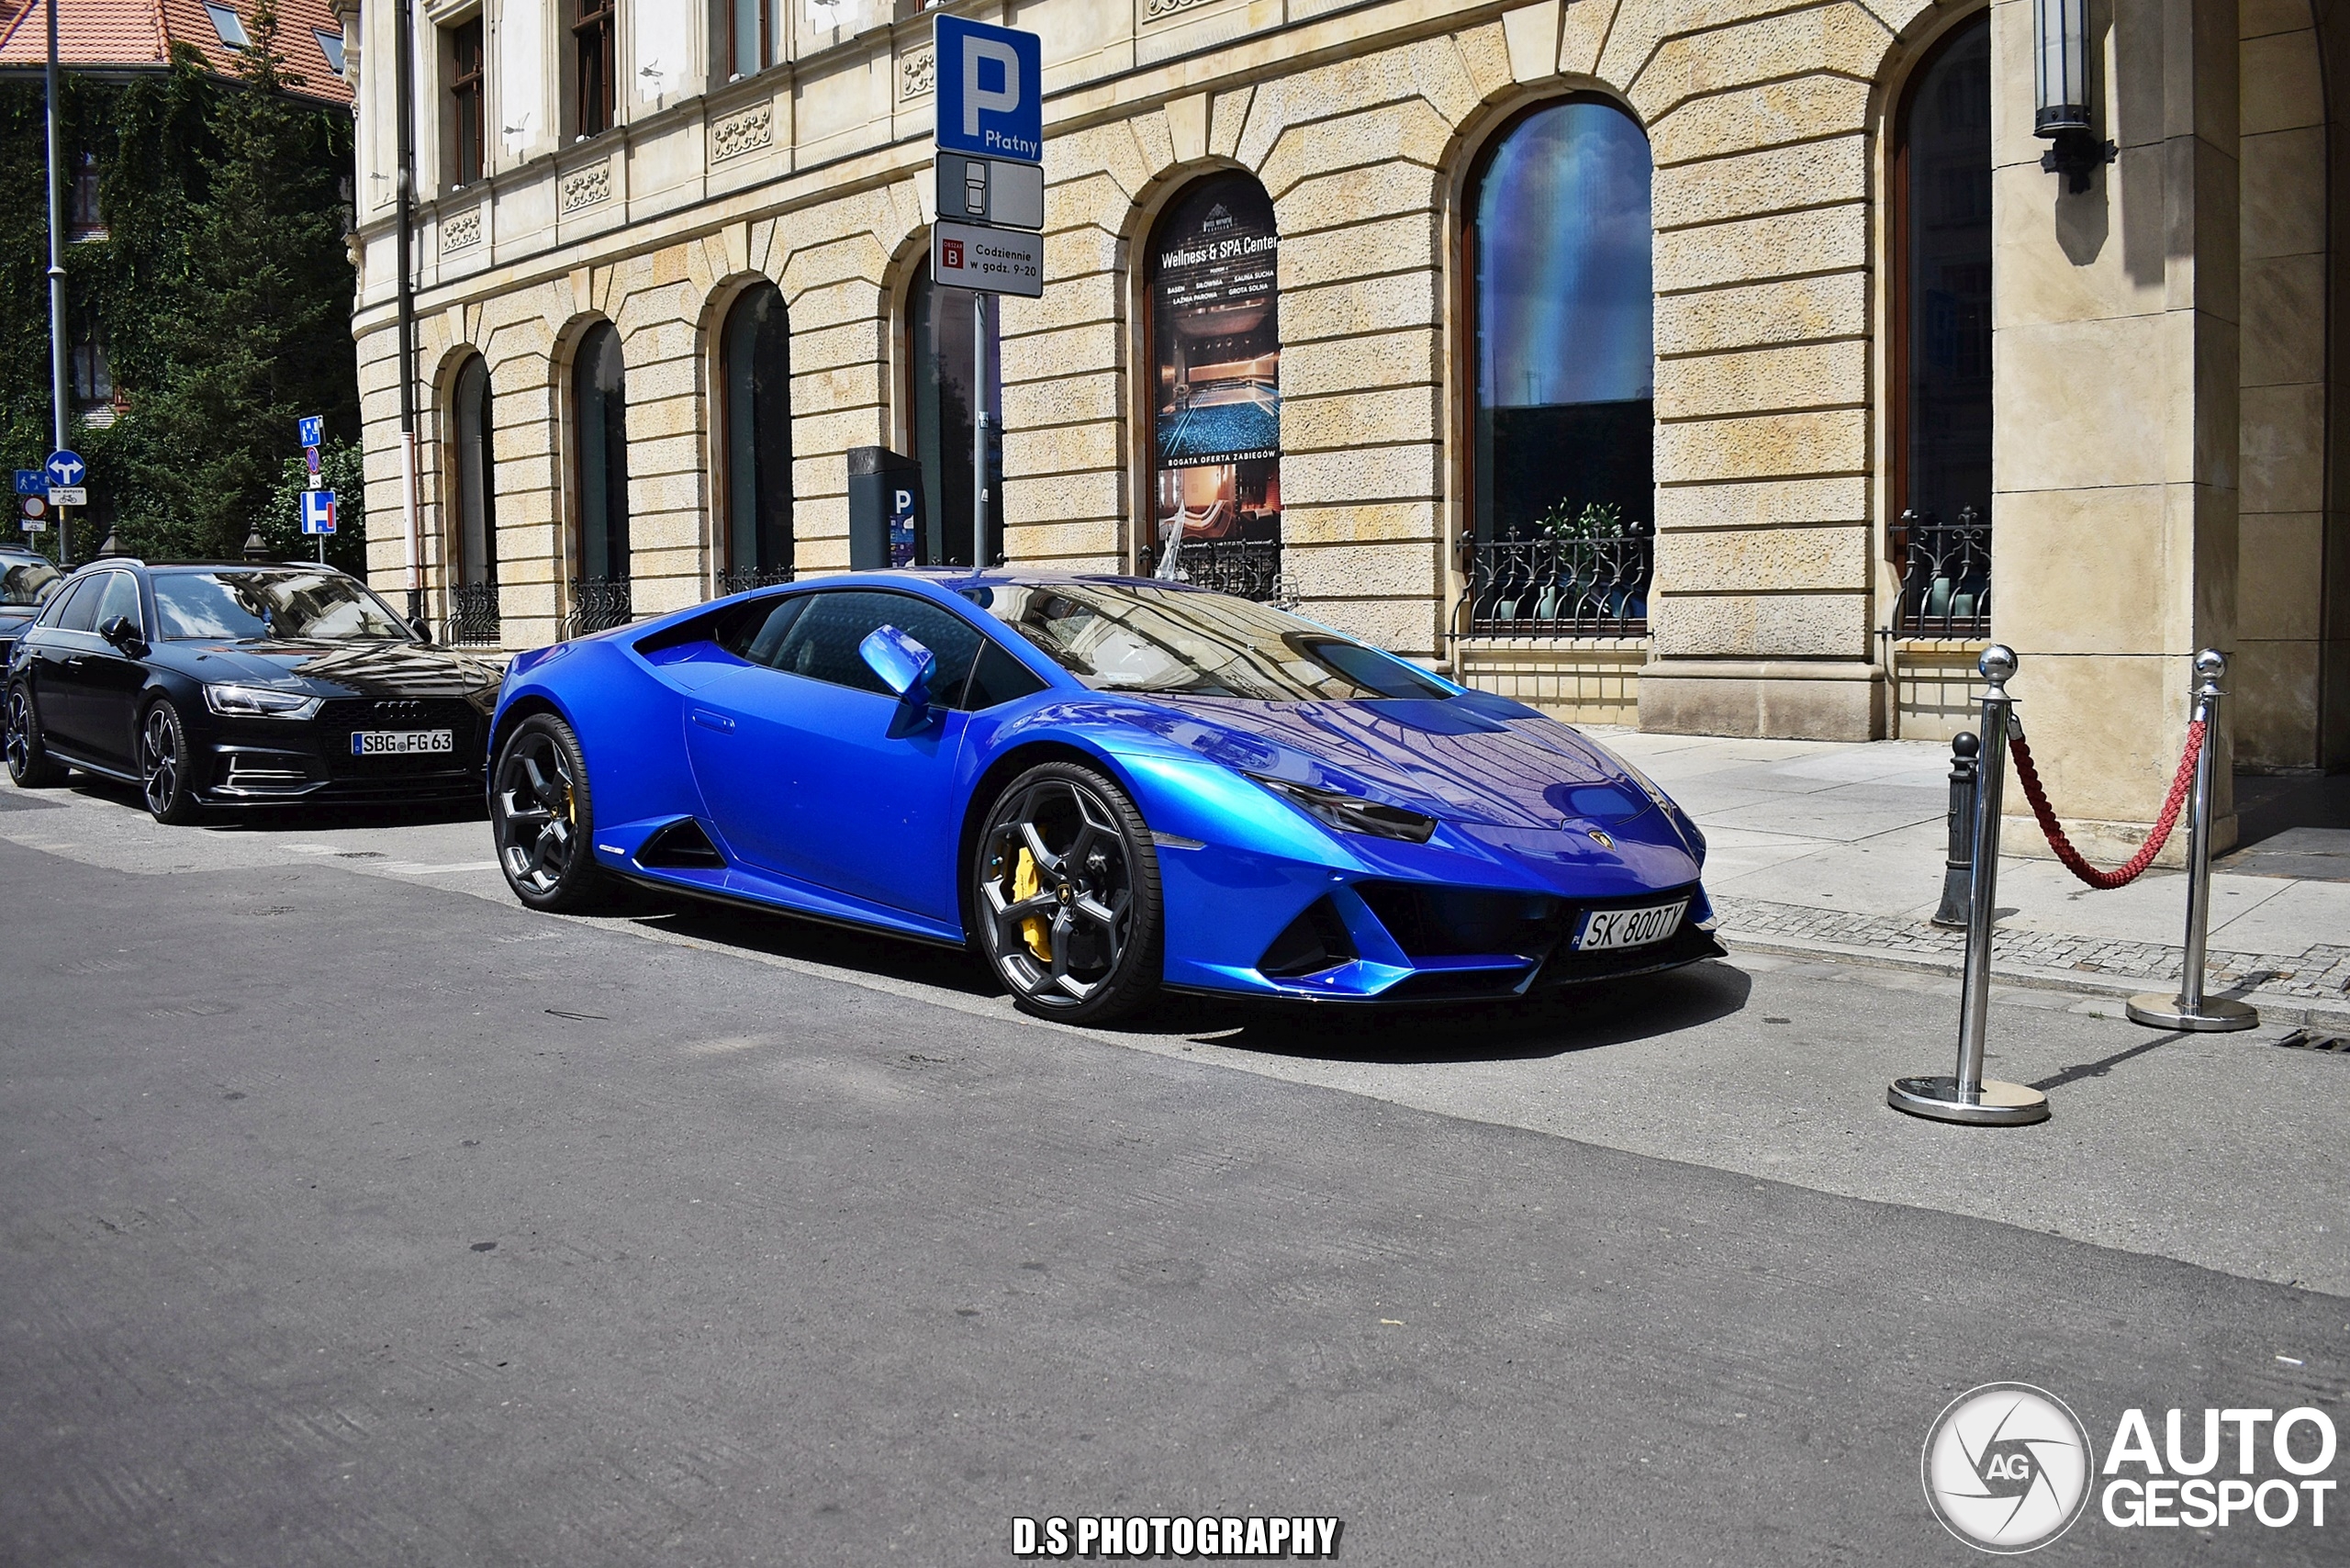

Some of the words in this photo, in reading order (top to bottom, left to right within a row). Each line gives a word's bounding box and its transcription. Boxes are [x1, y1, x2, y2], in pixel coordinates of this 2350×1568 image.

[963, 34, 1020, 137] P
[985, 129, 1038, 159] Płatny
[943, 241, 963, 250] OBSZAR
[975, 243, 1032, 262] Codziennie
[1161, 249, 1207, 269] Wellness
[1208, 243, 1218, 260] &
[1219, 239, 1242, 259] SPA
[1244, 235, 1279, 254] Center
[947, 250, 958, 265] B
[969, 261, 979, 269] w
[982, 262, 1010, 274] godz.
[1013, 264, 1036, 277] 9-20
[1168, 286, 1185, 295] BASEN
[1235, 274, 1254, 283] SAUNA
[1255, 270, 1274, 279] SUCHA
[1194, 292, 1217, 301] PAROWA
[1229, 286, 1248, 295] GROTA
[1249, 283, 1268, 292] SOLNA
[1168, 456, 1198, 466] BOGATA
[1200, 454, 1231, 465] OFERTA
[1233, 450, 1276, 462] ZABIEGÓW
[895, 489, 912, 514] P
[363, 734, 397, 753] SBG
[407, 734, 428, 752] FG
[431, 734, 452, 750] 63
[1587, 913, 1624, 946] SK
[1623, 904, 1684, 943] 800TY
